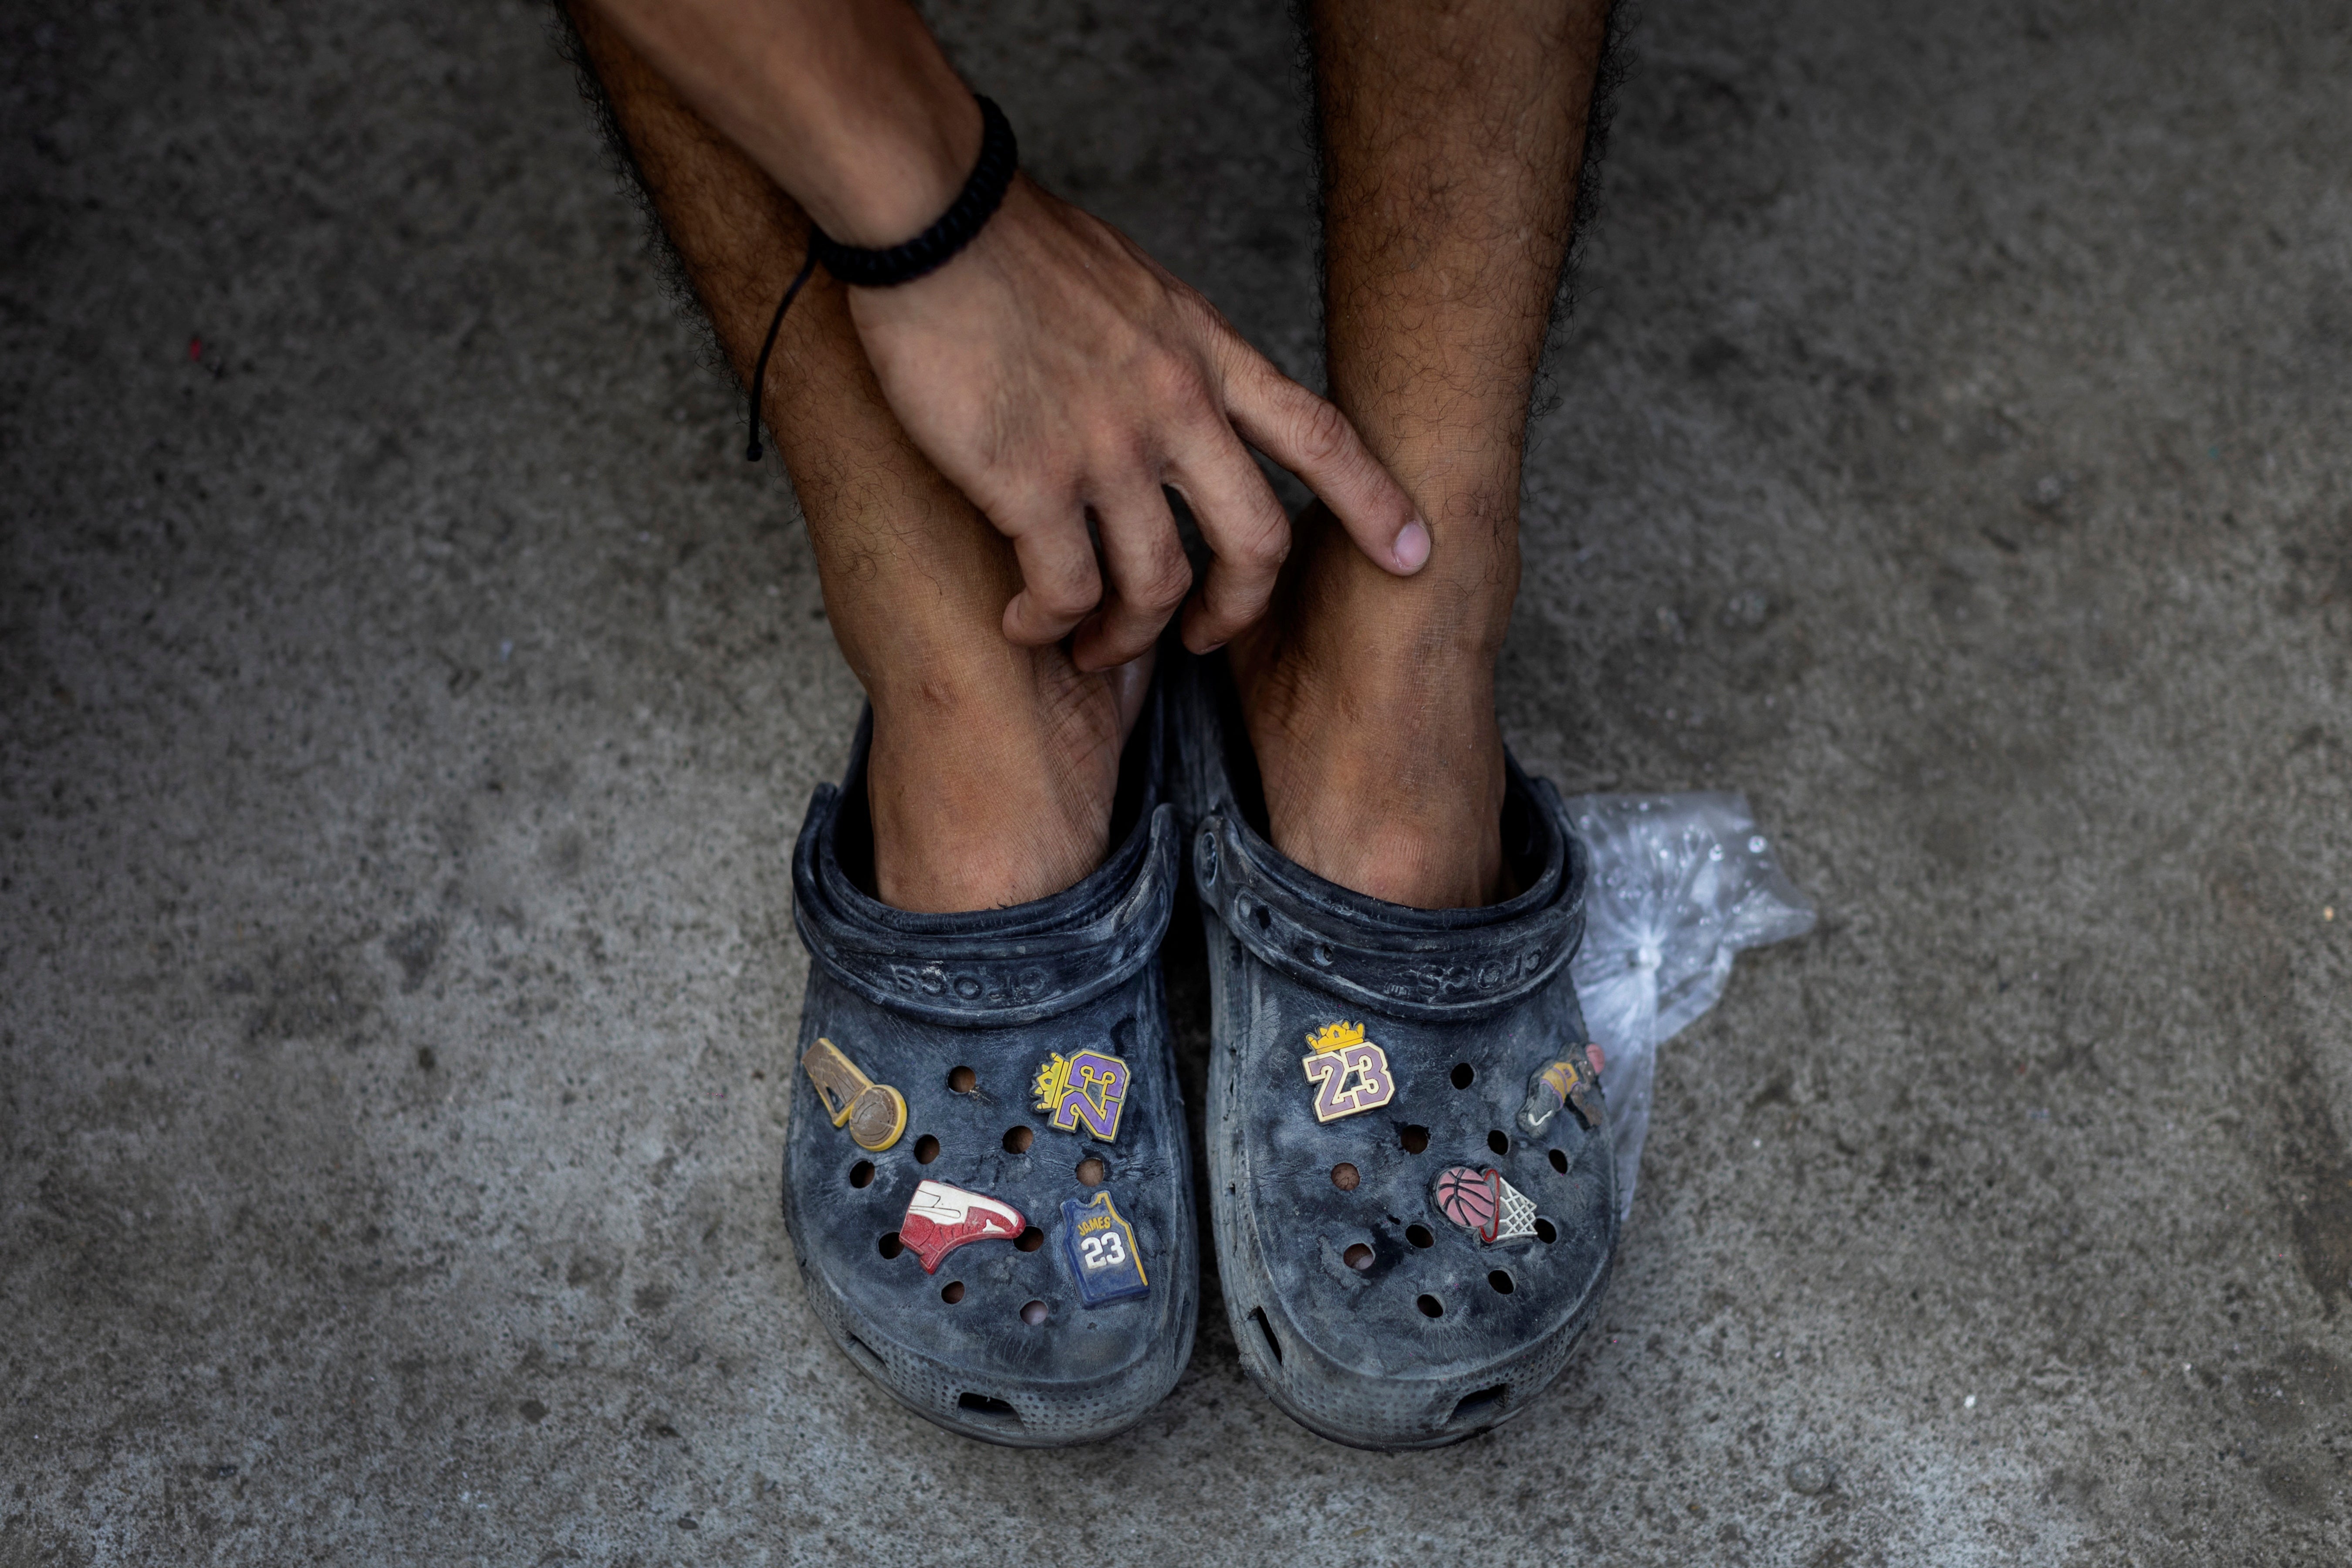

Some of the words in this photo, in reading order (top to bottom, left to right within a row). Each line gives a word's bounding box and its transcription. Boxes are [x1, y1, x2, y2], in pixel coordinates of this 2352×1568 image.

[1054, 1050, 1130, 1140] 23
[1303, 1041, 1395, 1122] 23
[1077, 1216, 1111, 1236] JAMES
[1081, 1232, 1125, 1269] 23
